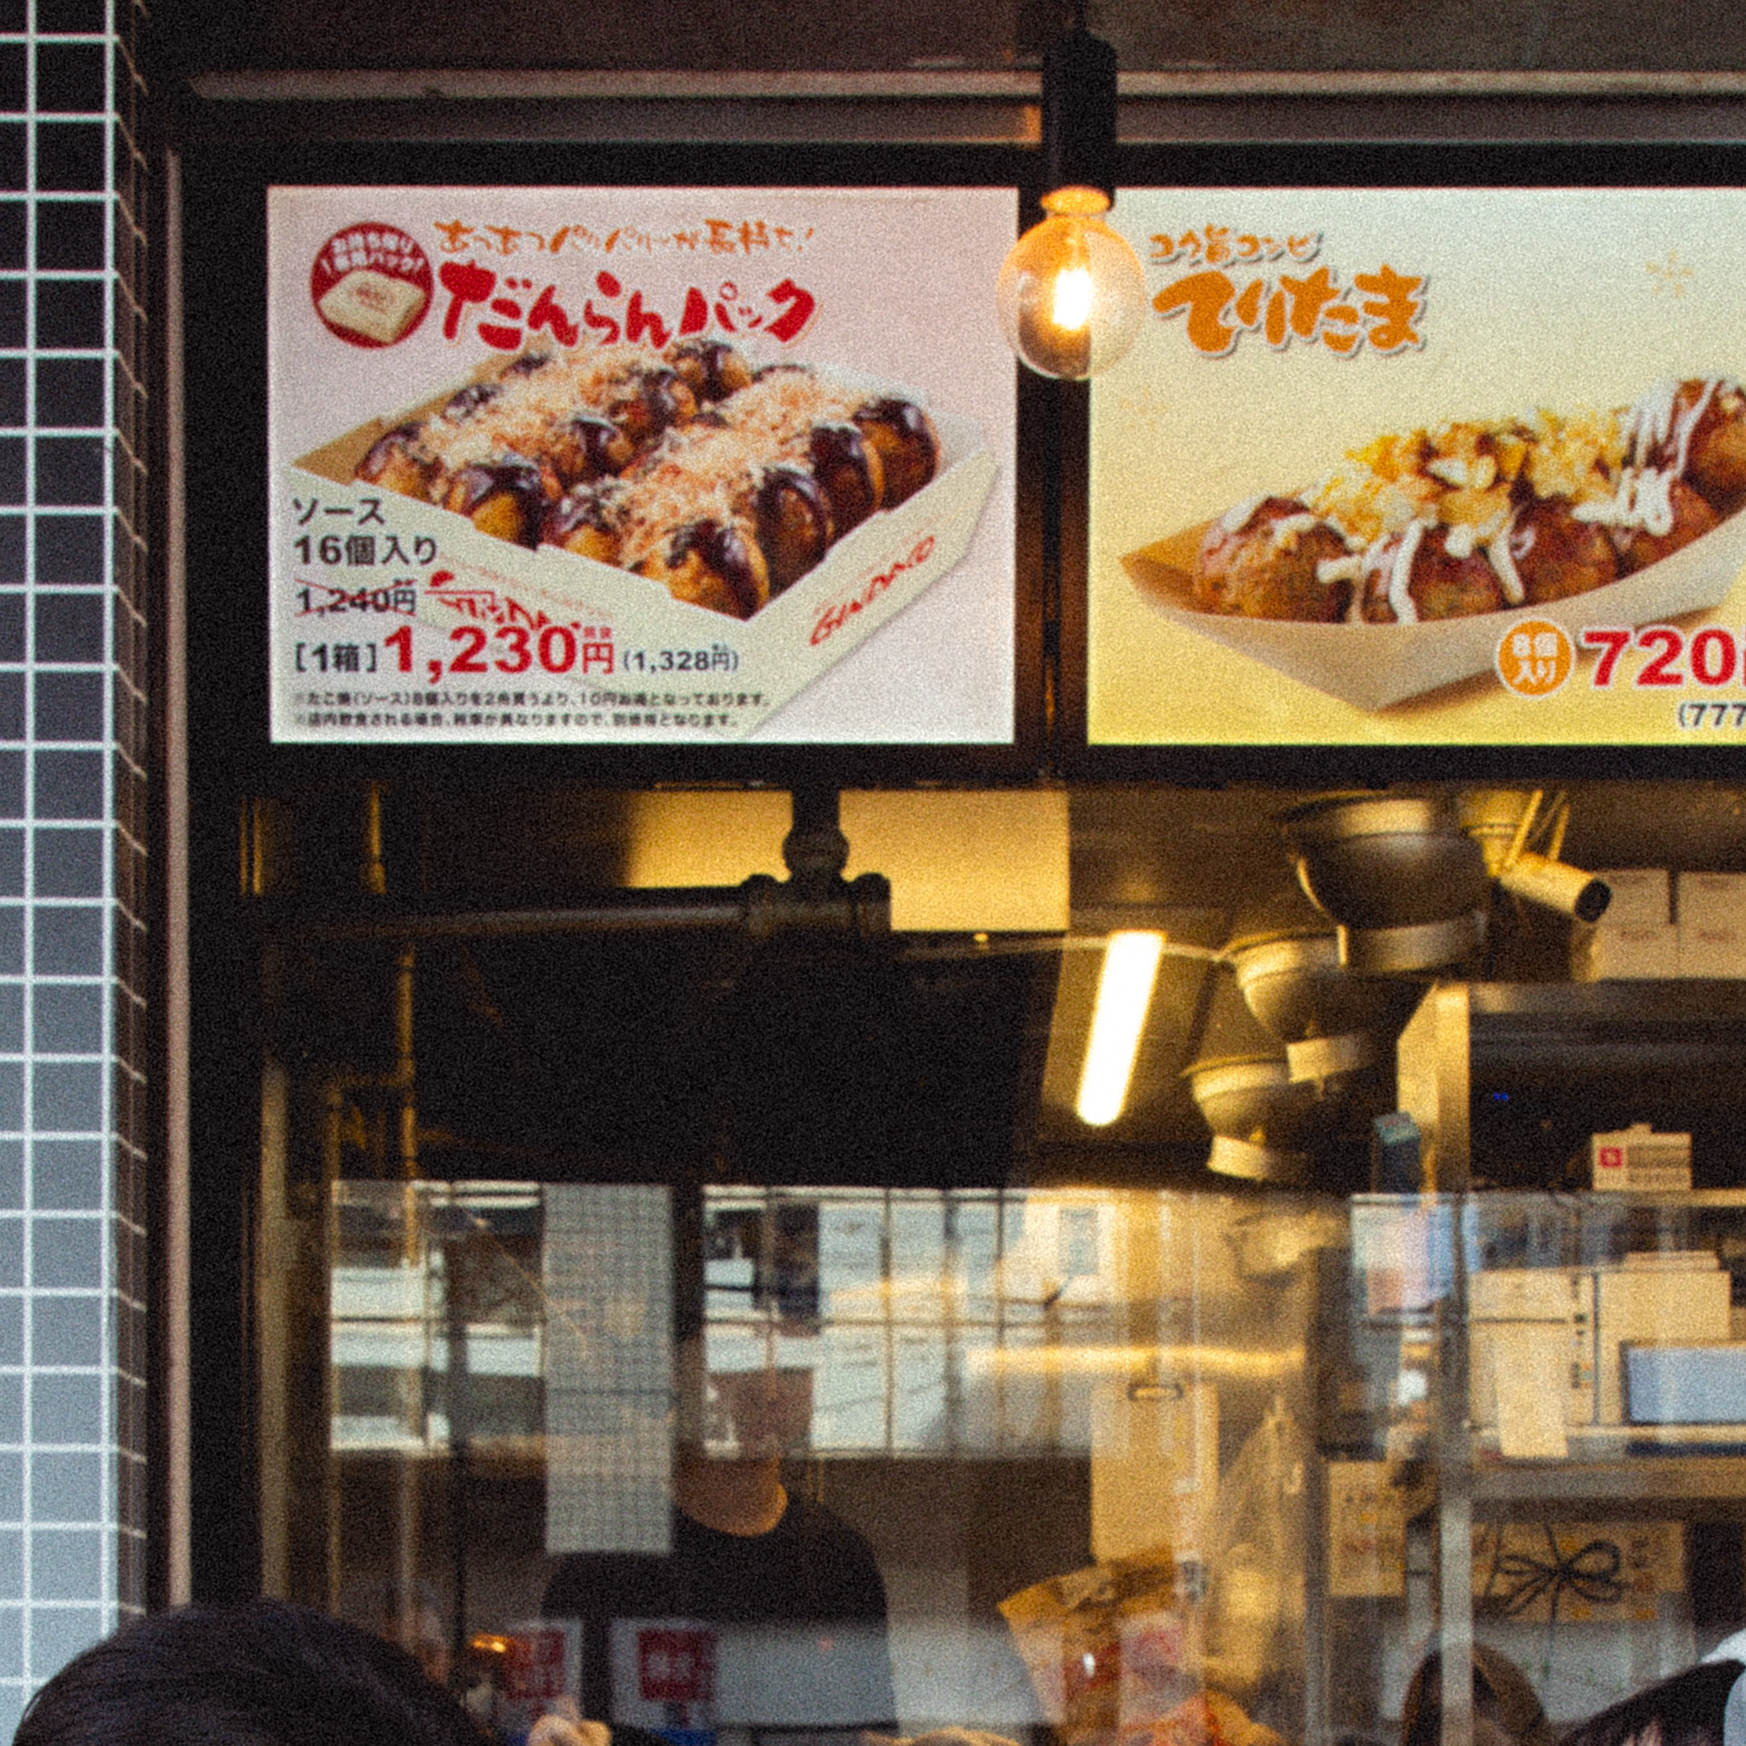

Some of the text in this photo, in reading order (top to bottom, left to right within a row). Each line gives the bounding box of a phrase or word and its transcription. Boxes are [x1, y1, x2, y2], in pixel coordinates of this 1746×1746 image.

[438, 259, 816, 351] だんらんパック
[1152, 263, 1424, 354] てりたま
[292, 497, 386, 526] ソース
[293, 534, 438, 566] 16個入り
[294, 625, 740, 684] [1箱] 1,230円 (1,328円)
[1512, 632, 1559, 658] 8個
[1512, 660, 1556, 686] 入り
